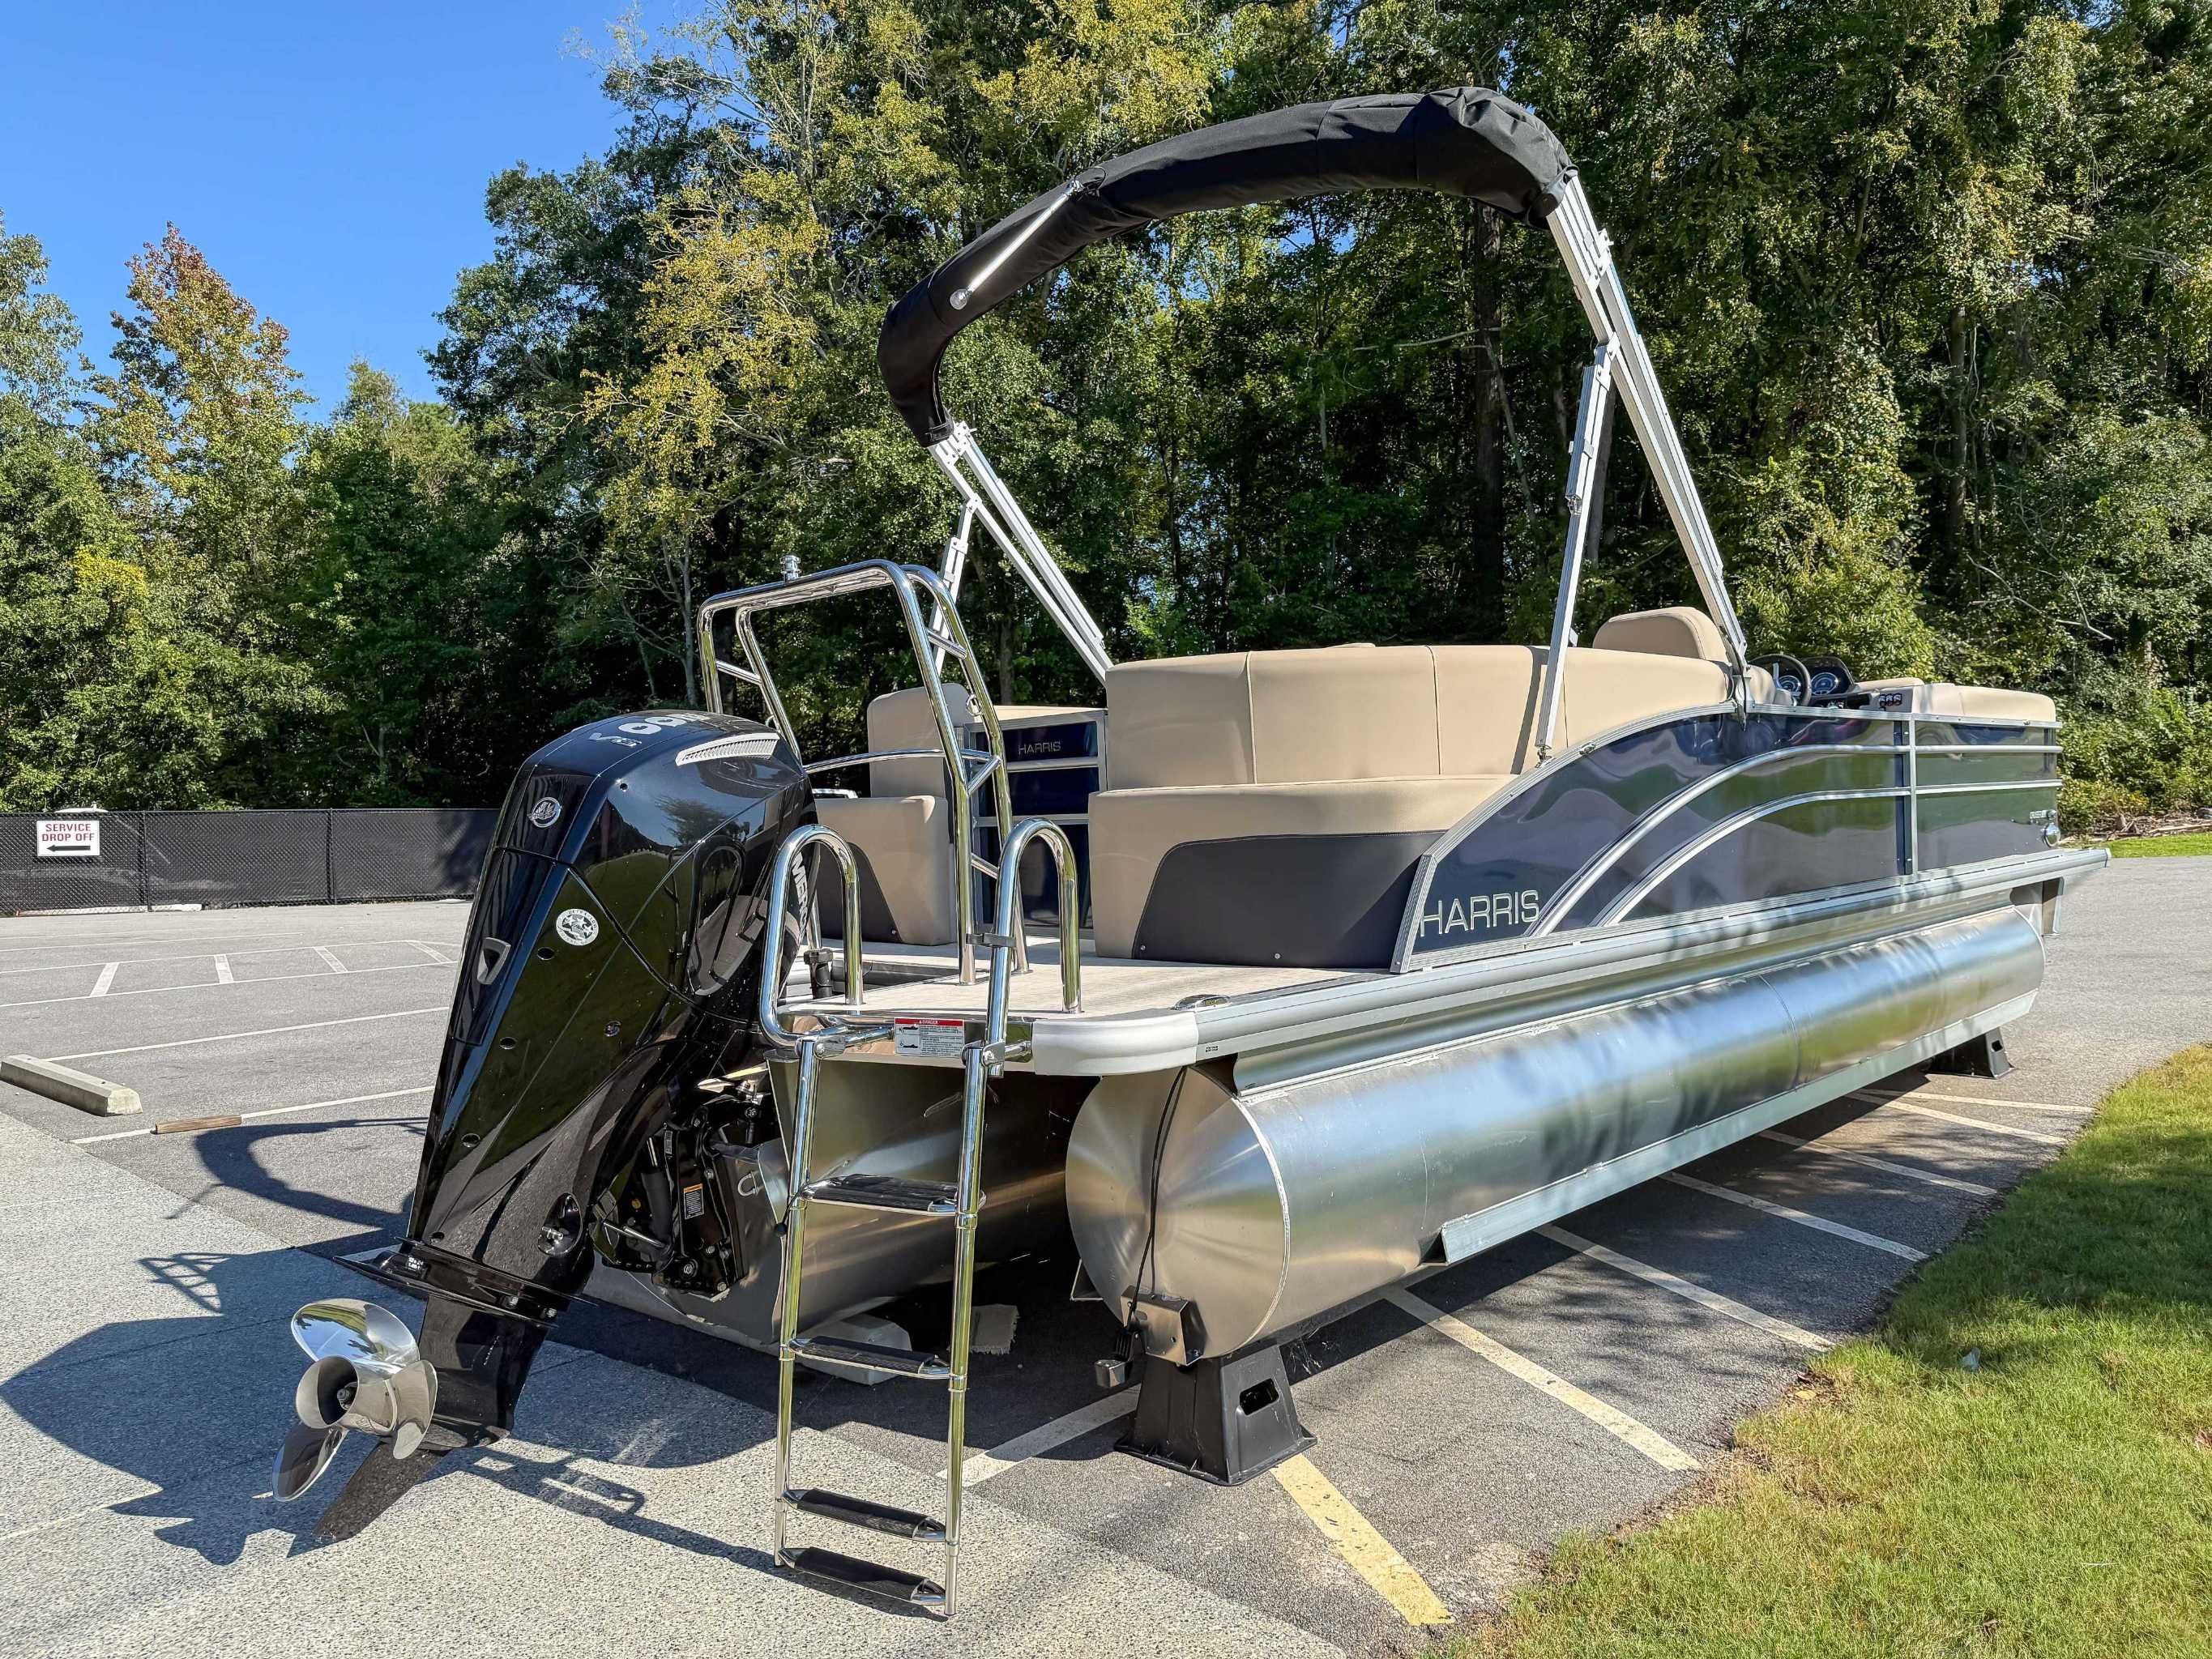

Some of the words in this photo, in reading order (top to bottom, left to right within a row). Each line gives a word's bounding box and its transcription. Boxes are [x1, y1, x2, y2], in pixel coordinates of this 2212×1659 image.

[1018, 740, 1061, 756] HARRIS
[45, 823, 92, 832] SERVICE
[41, 833, 71, 842] DROP
[75, 833, 95, 841] OFF
[1420, 889, 1539, 937] HARRIS
